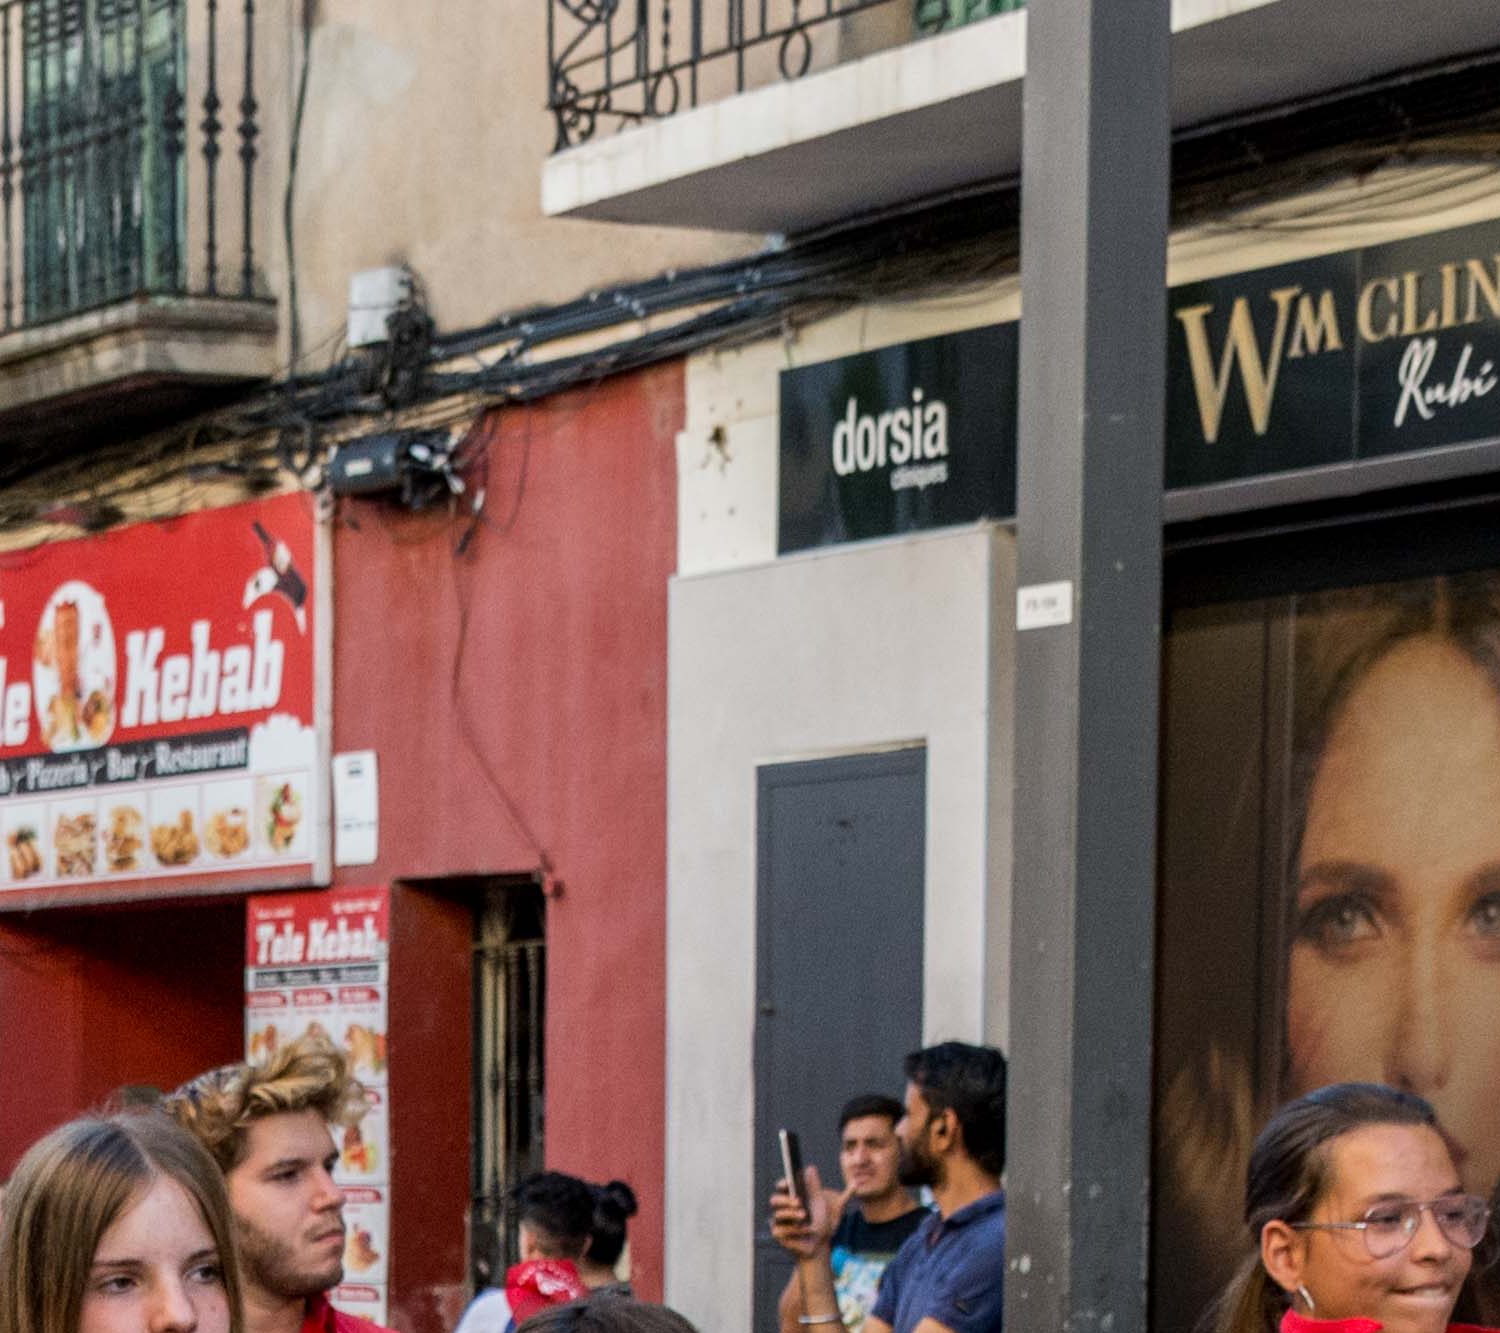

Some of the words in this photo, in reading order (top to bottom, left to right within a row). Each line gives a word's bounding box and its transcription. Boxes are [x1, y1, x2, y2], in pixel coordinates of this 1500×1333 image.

[832, 387, 949, 476] dorsia
[121, 609, 284, 728] Kebab
[106, 748, 138, 782] Bar
[255, 922, 305, 965] Tele
[307, 913, 379, 961] Kebab
